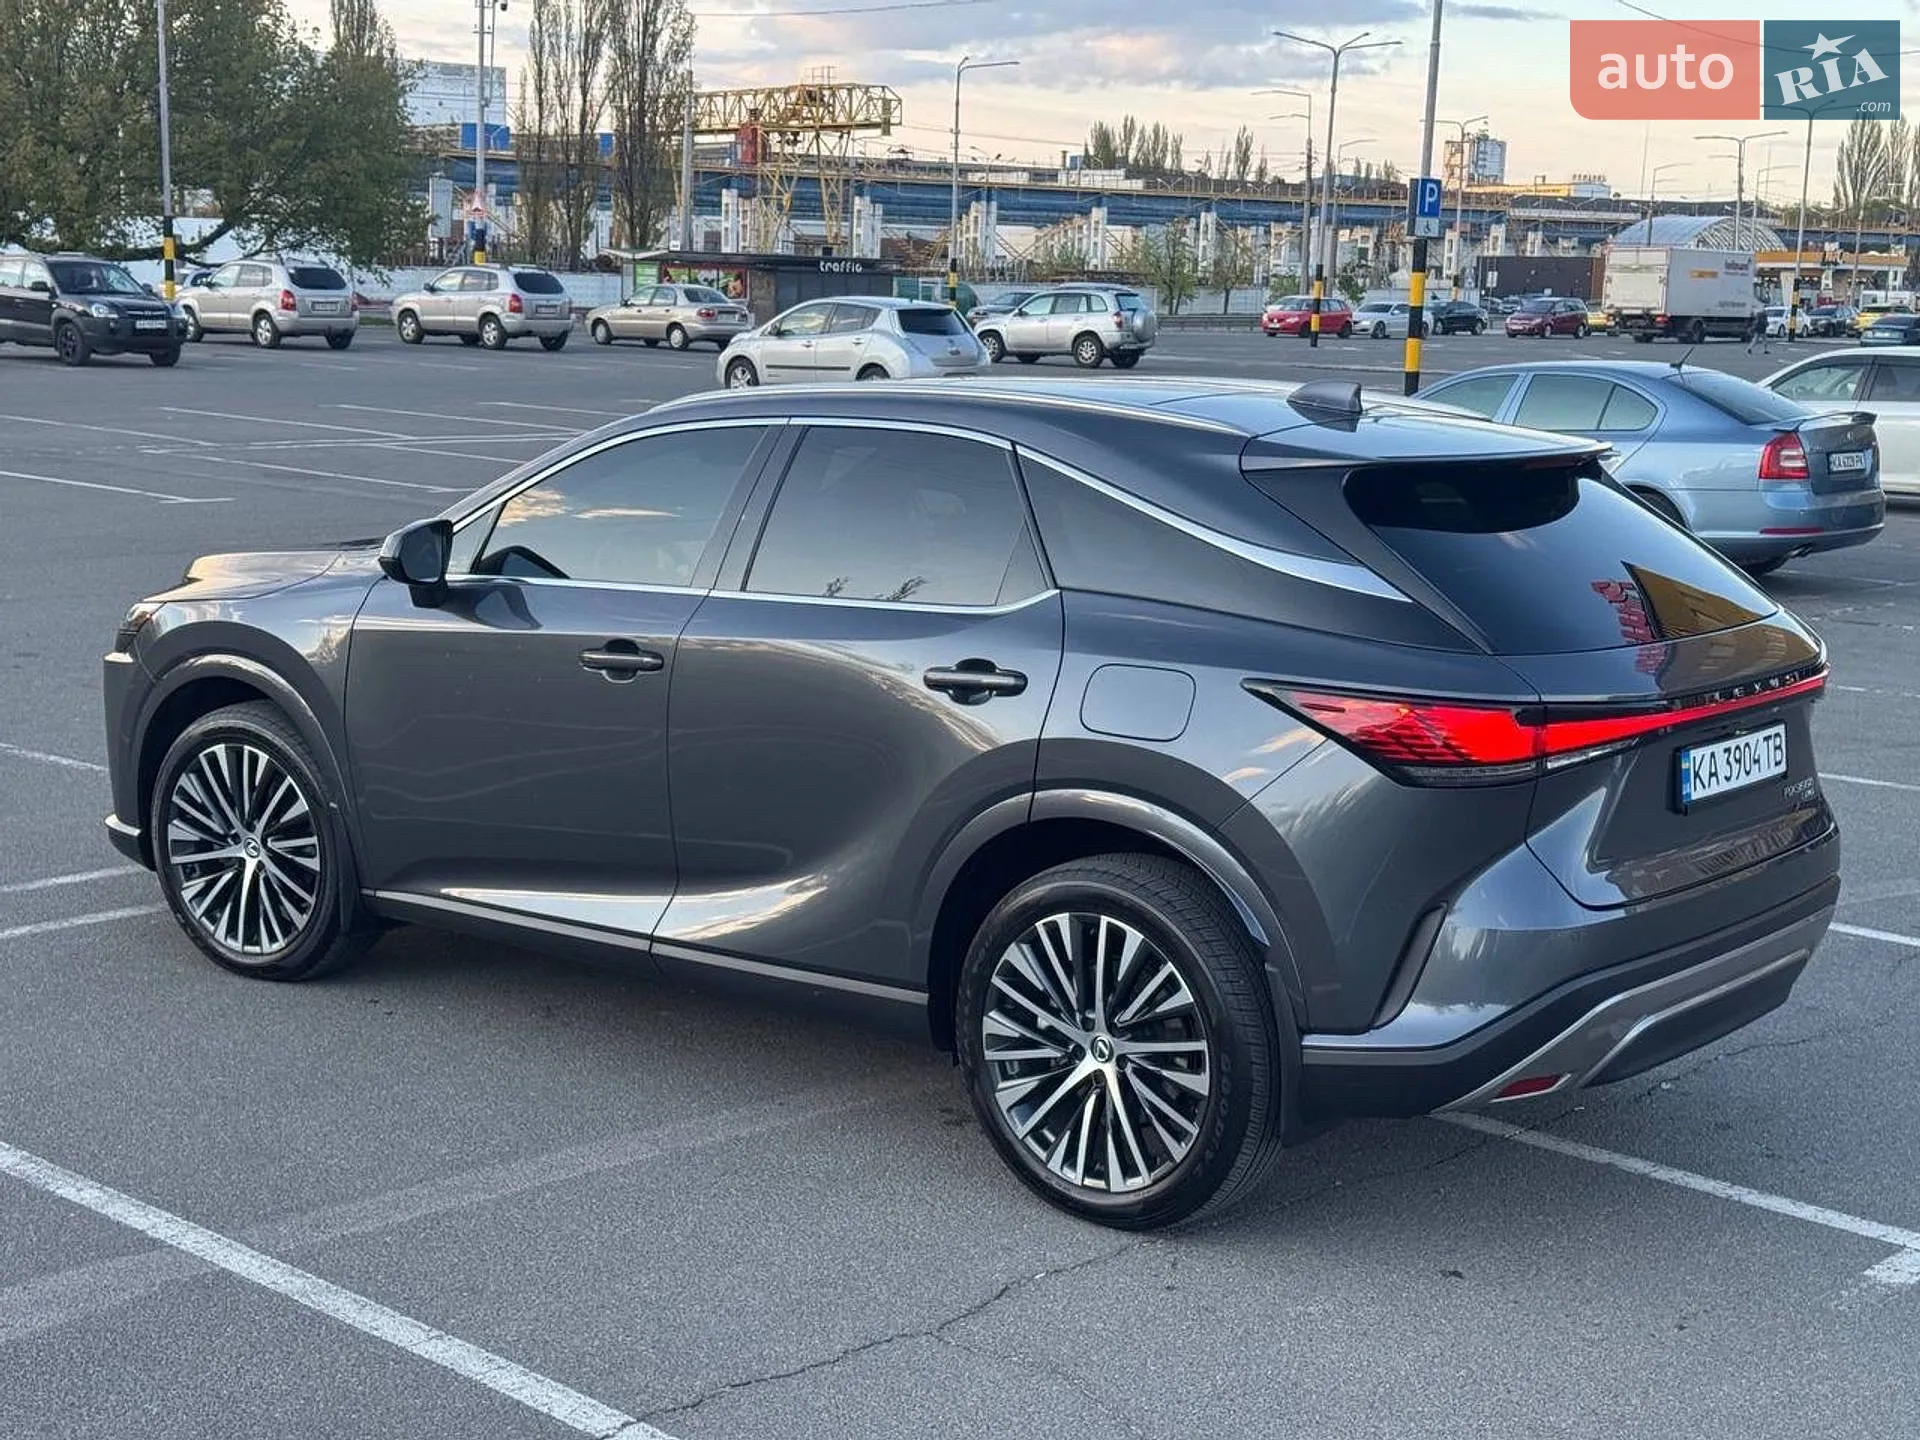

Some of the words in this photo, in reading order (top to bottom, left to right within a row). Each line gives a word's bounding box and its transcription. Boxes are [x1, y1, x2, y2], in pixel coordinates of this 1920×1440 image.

[1424, 183, 1438, 212] P
[820, 261, 862, 272] traffic
[1693, 751, 1720, 792] KA
[1723, 740, 1761, 782] 3904
[1763, 732, 1784, 770] TB
